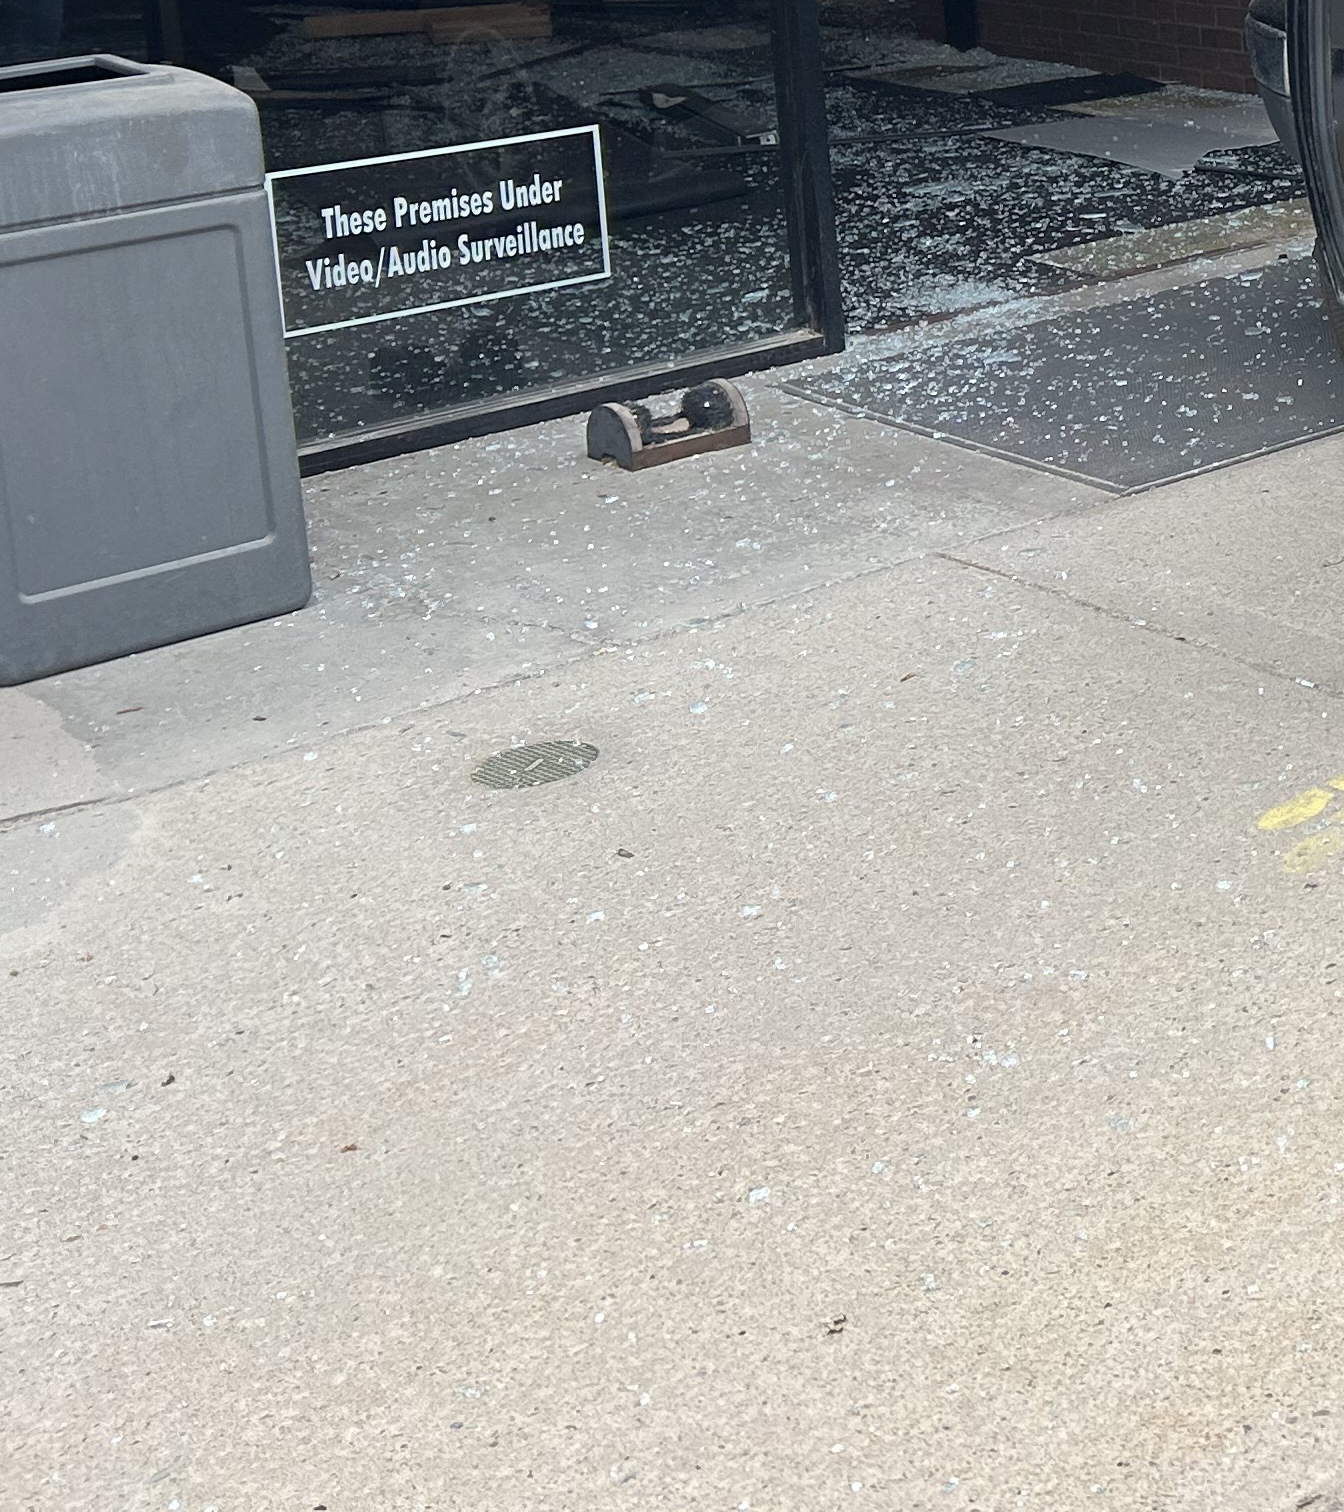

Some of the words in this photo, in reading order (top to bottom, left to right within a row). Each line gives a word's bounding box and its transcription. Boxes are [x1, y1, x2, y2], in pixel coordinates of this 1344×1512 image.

[321, 205, 387, 239] These
[394, 188, 493, 229] Premises
[500, 173, 563, 210] Under
[306, 240, 452, 290] Video/Audio
[458, 220, 586, 265] Surveillance
